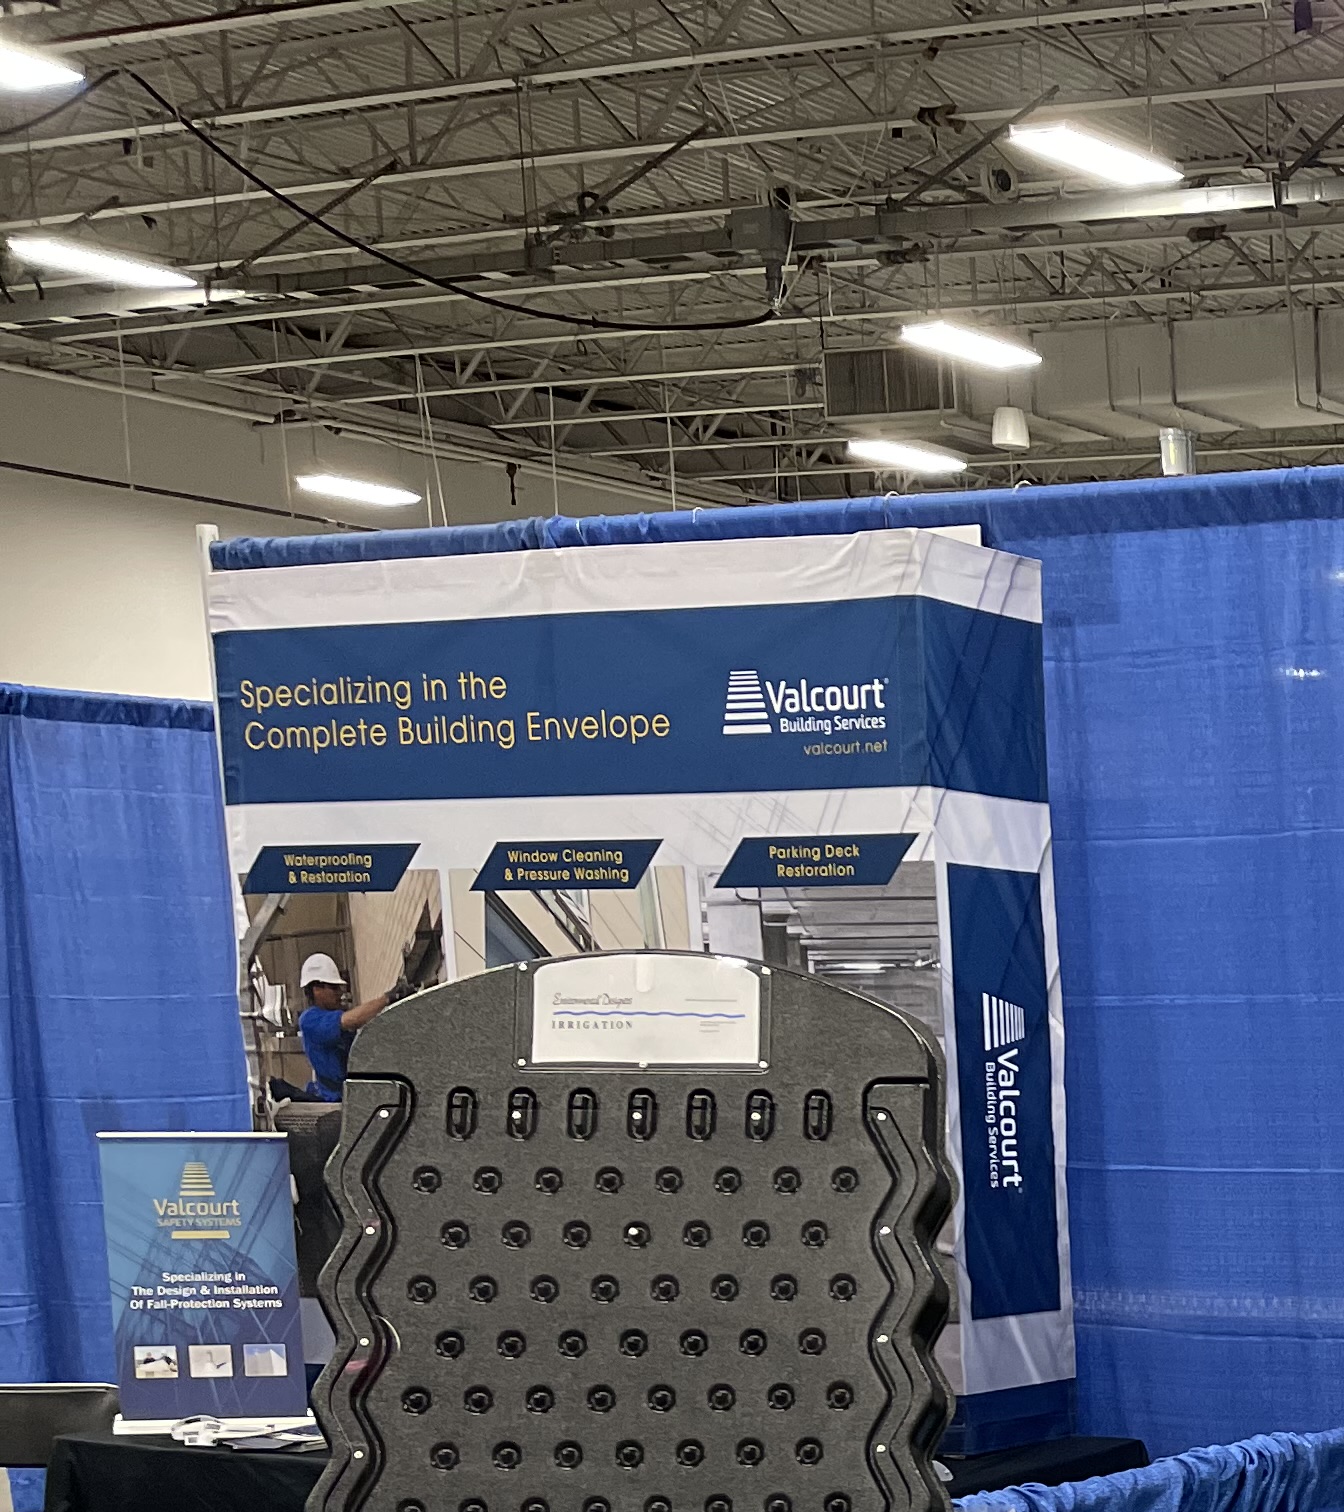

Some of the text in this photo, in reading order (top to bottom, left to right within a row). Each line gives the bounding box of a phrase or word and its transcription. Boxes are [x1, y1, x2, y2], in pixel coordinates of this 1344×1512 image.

[240, 671, 507, 713] Specializing in the
[764, 678, 886, 714] Valcourt
[244, 708, 671, 754] Complete Building Envelope
[779, 714, 887, 736] Building Services
[803, 738, 889, 756] valcourt.net
[283, 853, 373, 868] Waterproofing
[507, 848, 623, 865] Window Cleaning
[768, 844, 860, 862] Parking Deck
[288, 870, 371, 884] & Restoration
[504, 866, 629, 882] & Pressure Washing
[777, 863, 855, 878] Restoration
[551, 1019, 633, 1030] IRRIGATION
[985, 1061, 1000, 1189] Building Services
[996, 1047, 1024, 1189] Valcourt
[153, 1198, 240, 1217] Valcourt
[162, 1271, 246, 1284] Specializing in
[131, 1284, 278, 1298] The Design & Installation
[130, 1298, 283, 1310] Of Fall-Protection Systems
